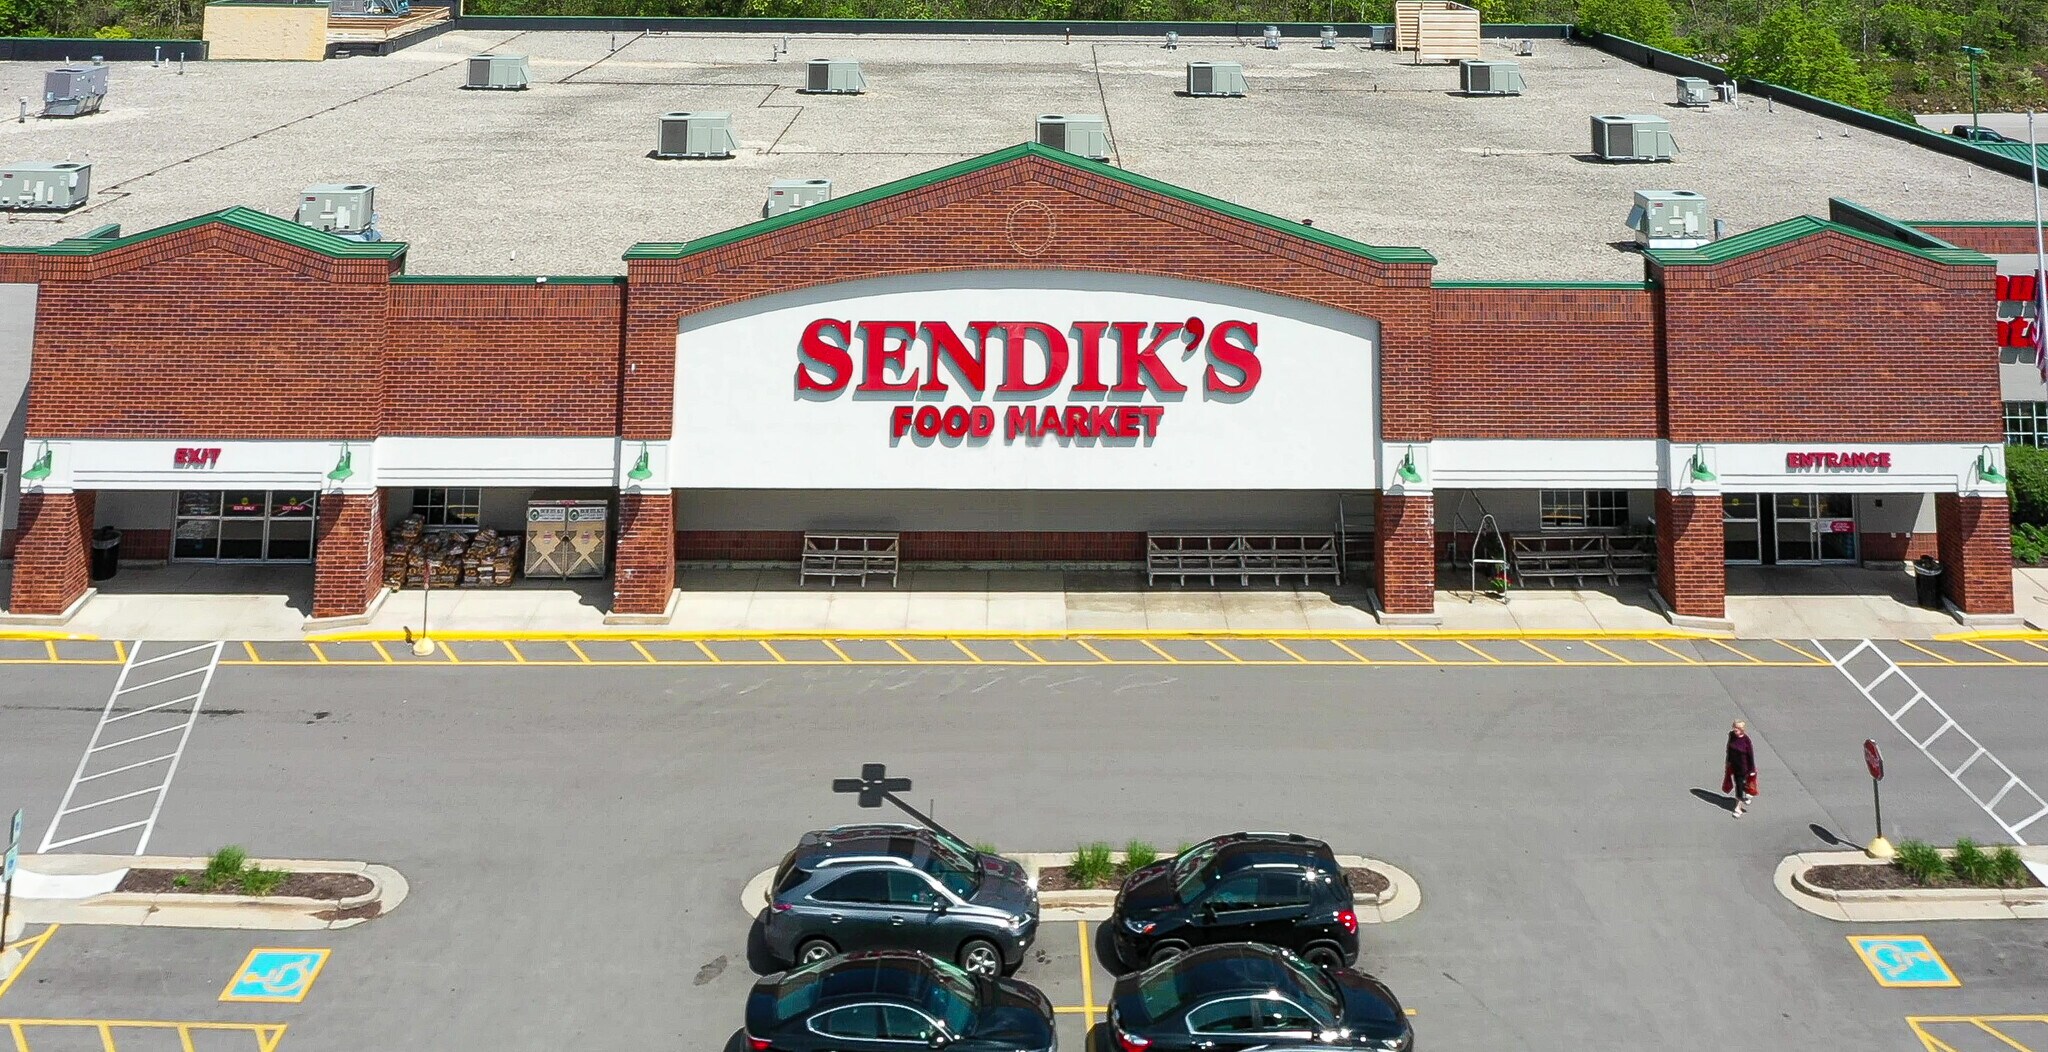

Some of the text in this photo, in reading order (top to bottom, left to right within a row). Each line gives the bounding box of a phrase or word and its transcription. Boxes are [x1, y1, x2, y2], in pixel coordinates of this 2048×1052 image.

[893, 405, 1165, 440] FOOD MARKET
[175, 447, 222, 465] EXIT
[1786, 452, 1891, 468] ENTRANCE
